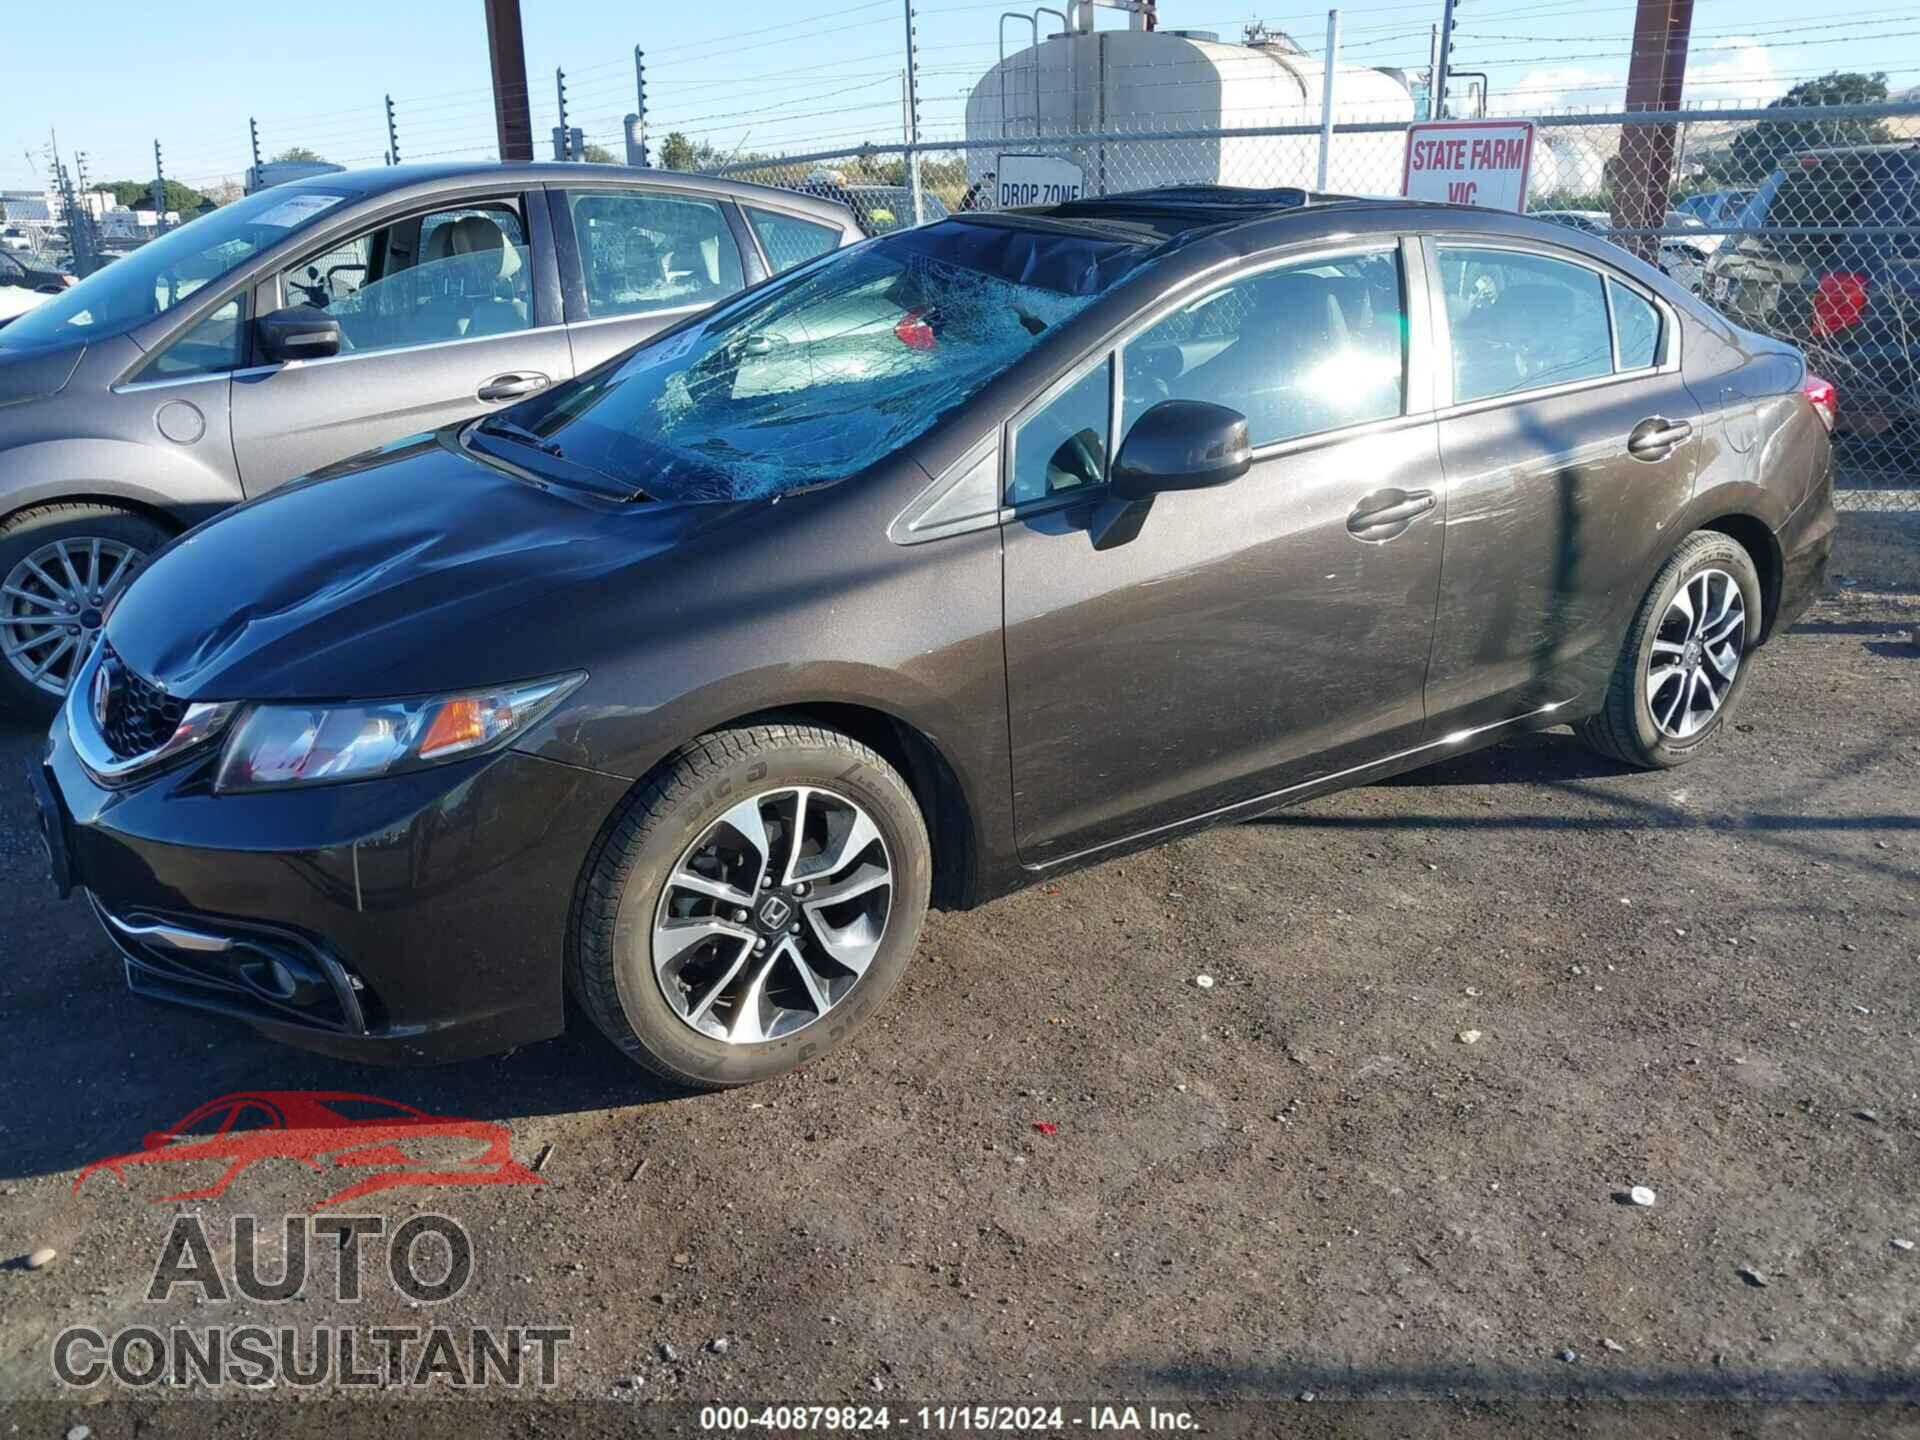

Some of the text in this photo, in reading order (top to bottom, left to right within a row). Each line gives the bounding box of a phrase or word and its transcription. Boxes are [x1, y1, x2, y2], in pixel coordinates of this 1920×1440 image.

[1413, 138, 1525, 170] STATE FARM
[1001, 183, 1079, 206] DROP ZONE
[1448, 181, 1477, 204] VIC
